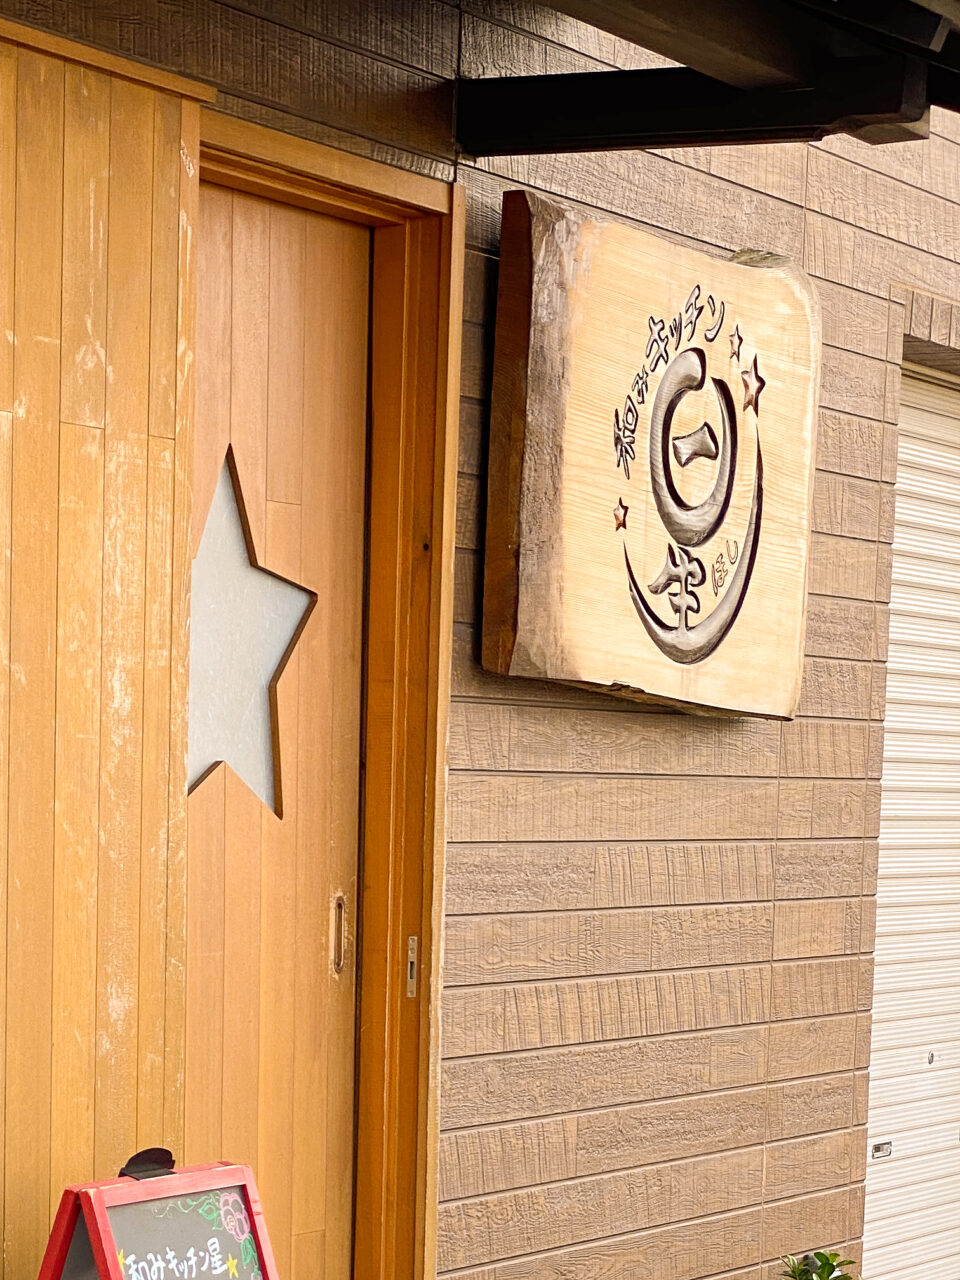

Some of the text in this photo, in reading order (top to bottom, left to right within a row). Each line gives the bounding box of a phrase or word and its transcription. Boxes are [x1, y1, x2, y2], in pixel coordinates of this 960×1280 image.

[613, 284, 726, 480] 和みキッチン
[711, 538, 739, 597] ほし
